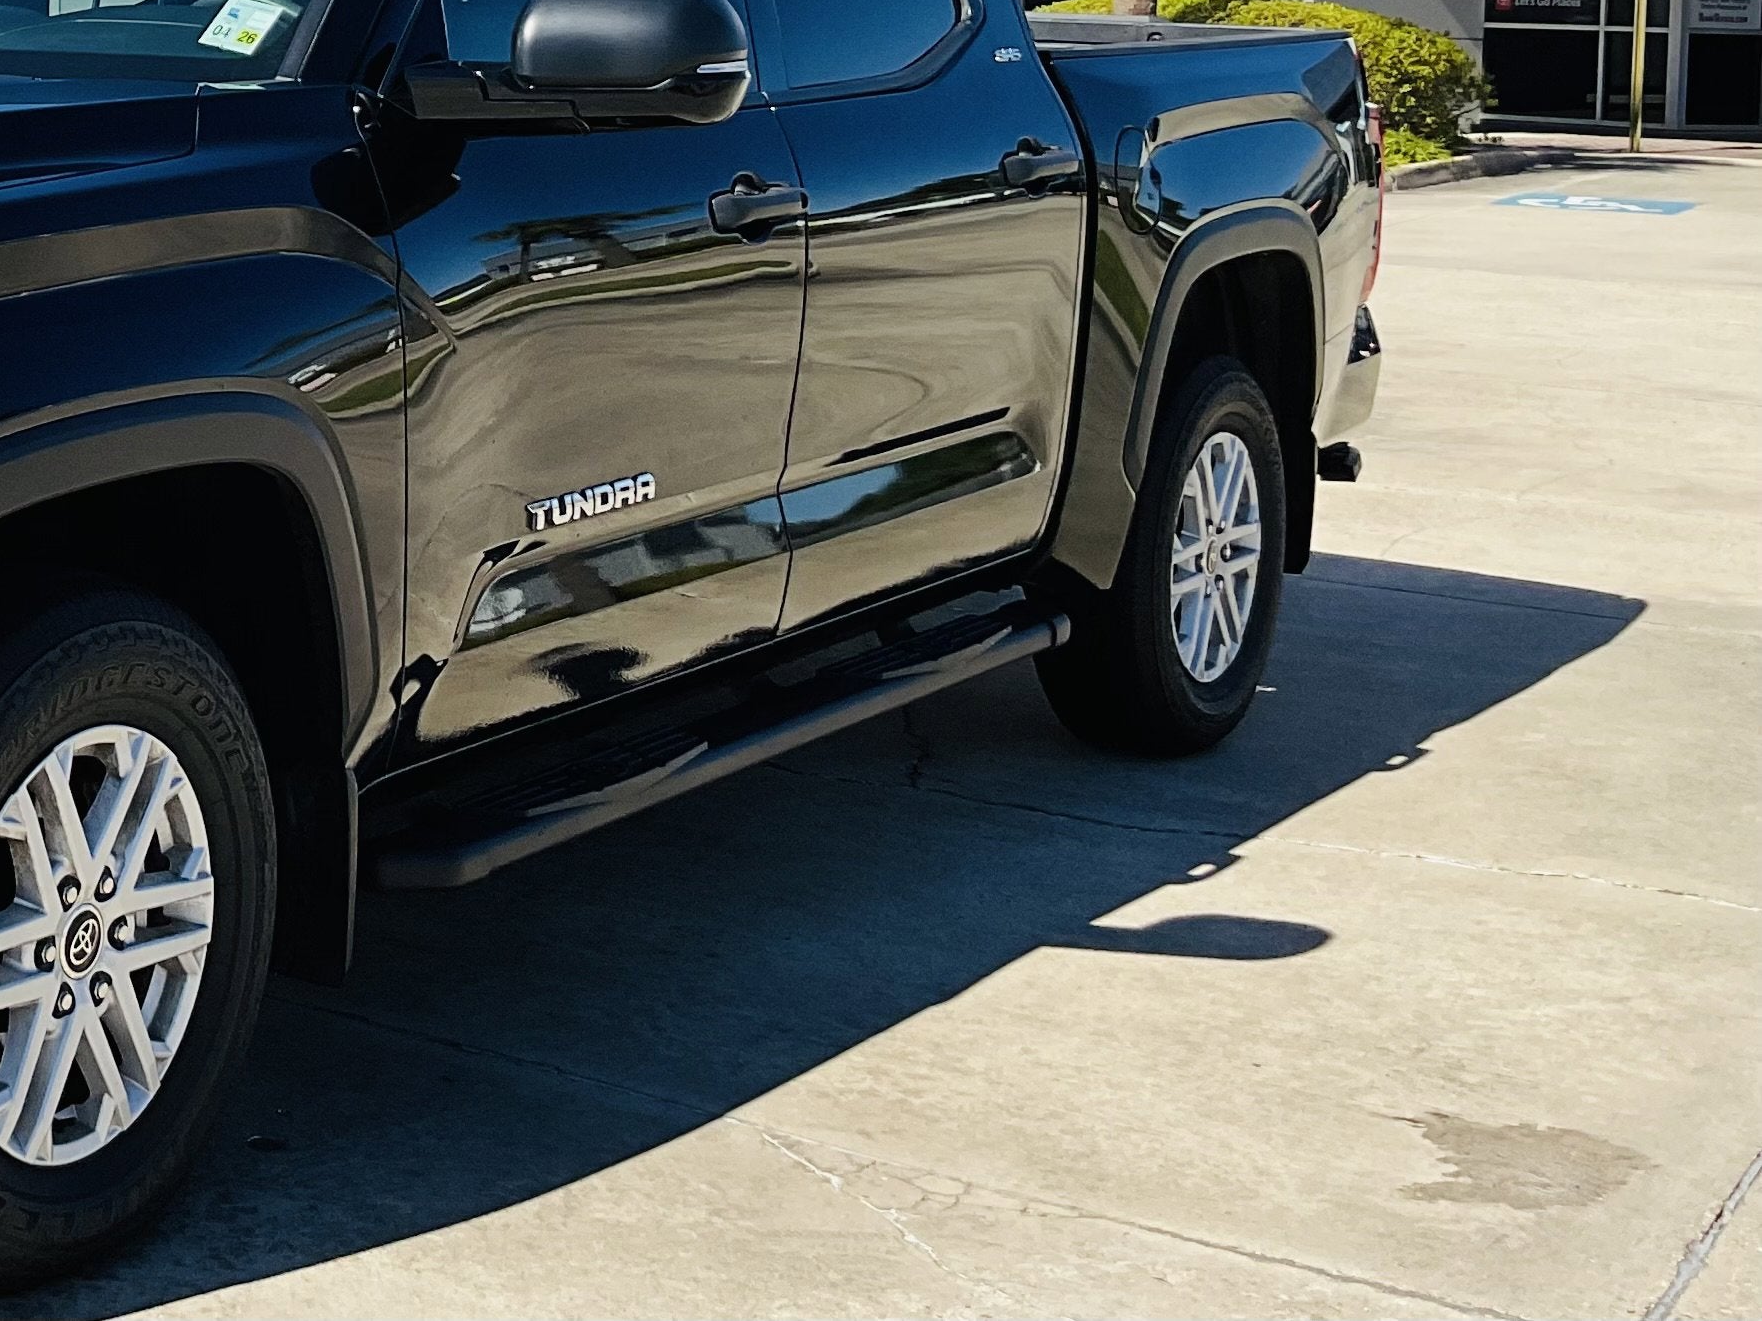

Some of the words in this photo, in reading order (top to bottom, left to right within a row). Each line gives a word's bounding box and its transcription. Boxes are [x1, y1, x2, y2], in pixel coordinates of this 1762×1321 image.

[212, 24, 232, 38] 04
[237, 30, 258, 44] 26
[526, 471, 656, 531] TUNDRA
